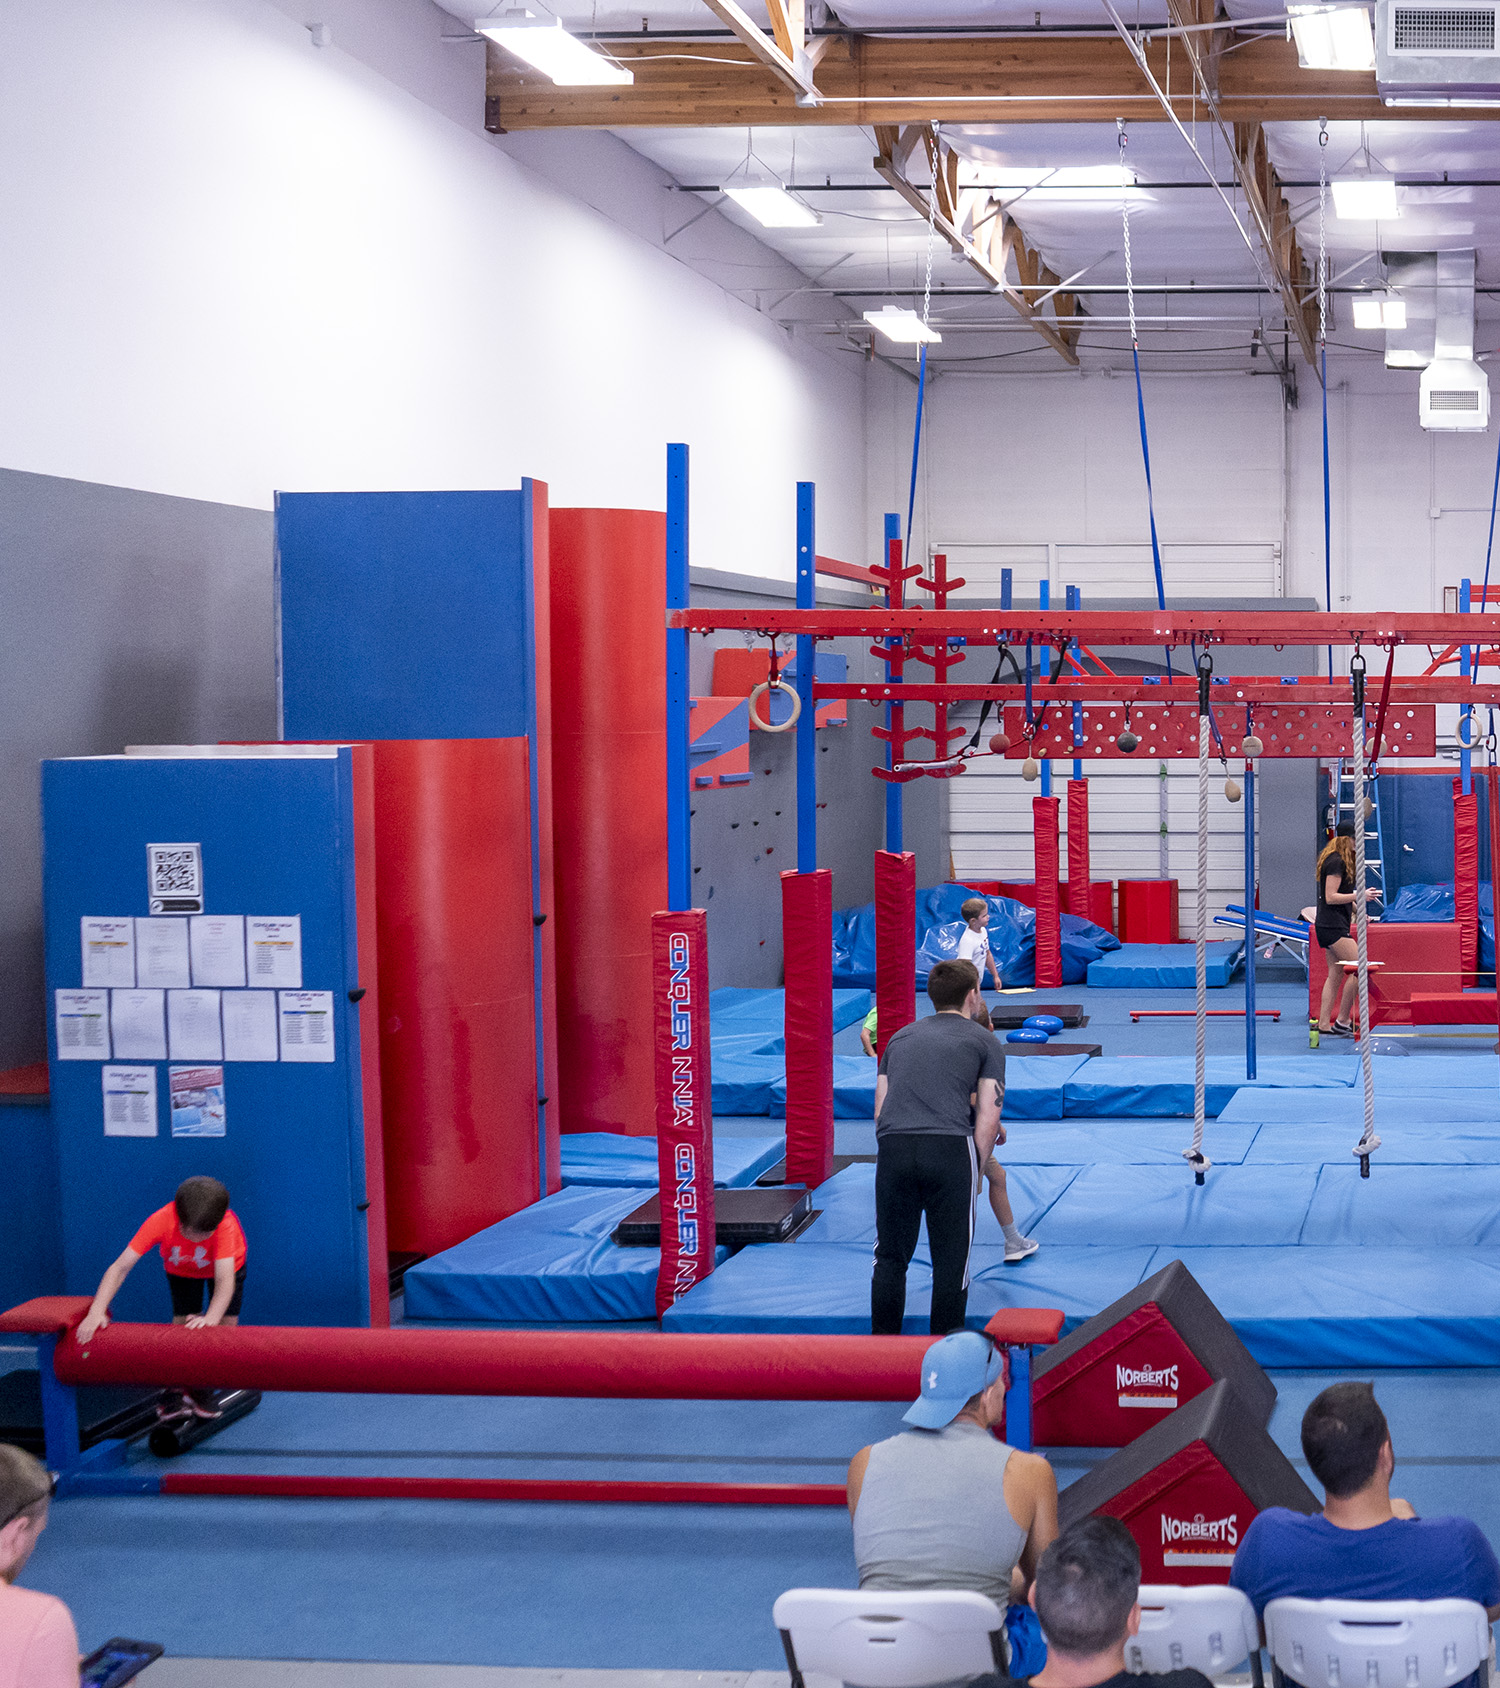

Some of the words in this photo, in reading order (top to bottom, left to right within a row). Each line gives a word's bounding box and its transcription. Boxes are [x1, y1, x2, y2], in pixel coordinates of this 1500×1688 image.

[668, 932, 691, 1051] CONQUER
[674, 1142, 699, 1256] CONQUER
[1116, 1364, 1179, 1391] NORBERTS
[1161, 1513, 1238, 1546] NORBERTS
